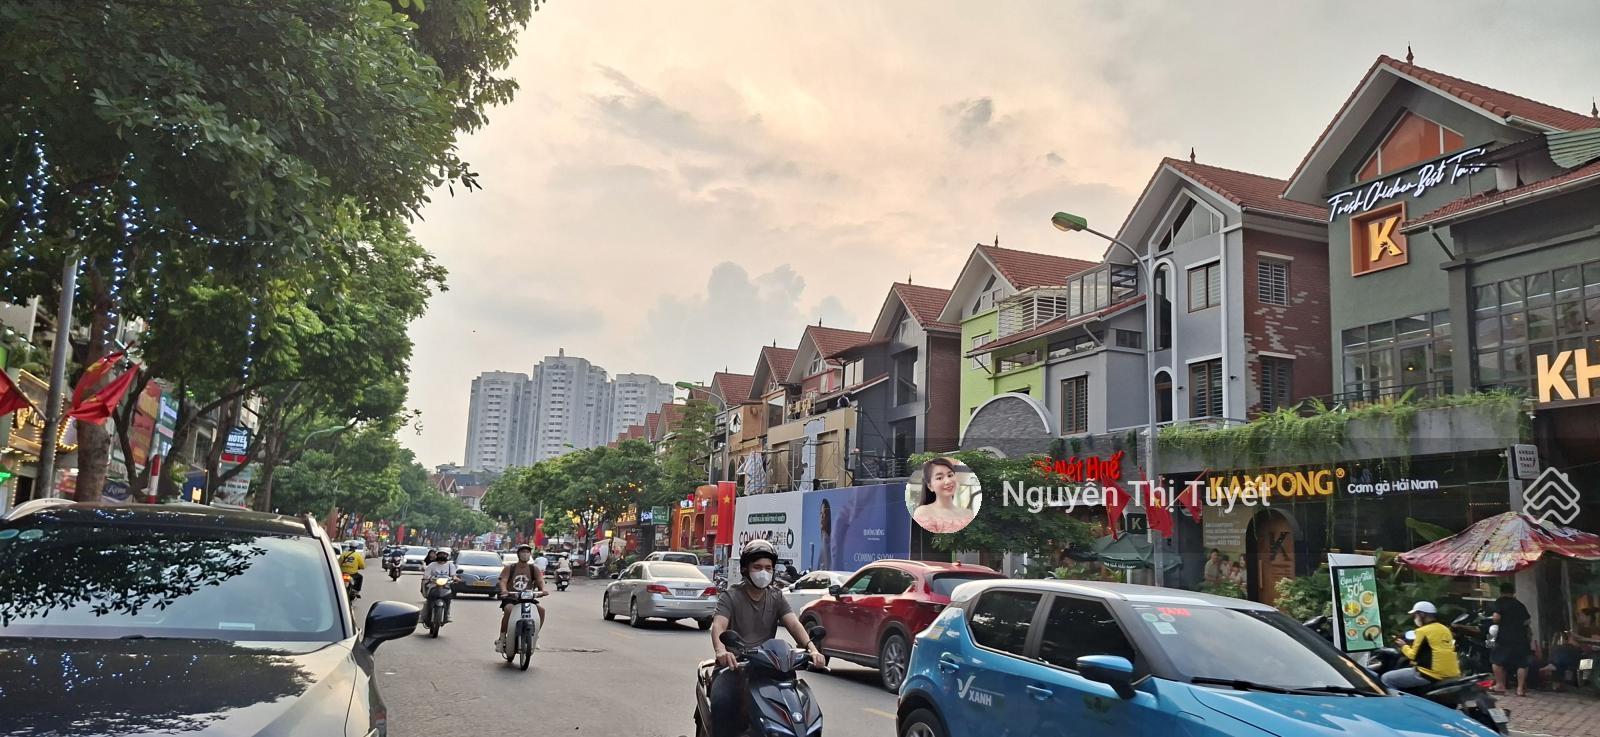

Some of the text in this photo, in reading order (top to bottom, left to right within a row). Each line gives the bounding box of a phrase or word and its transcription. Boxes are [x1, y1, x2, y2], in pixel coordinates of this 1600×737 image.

[1368, 216, 1404, 263] K
[1086, 450, 1124, 480] Huế
[1209, 469, 1334, 500] KAMPONG
[1347, 478, 1438, 495] Cơm gà Hải Nam
[1132, 517, 1144, 530] K
[969, 690, 992, 706] XANH
